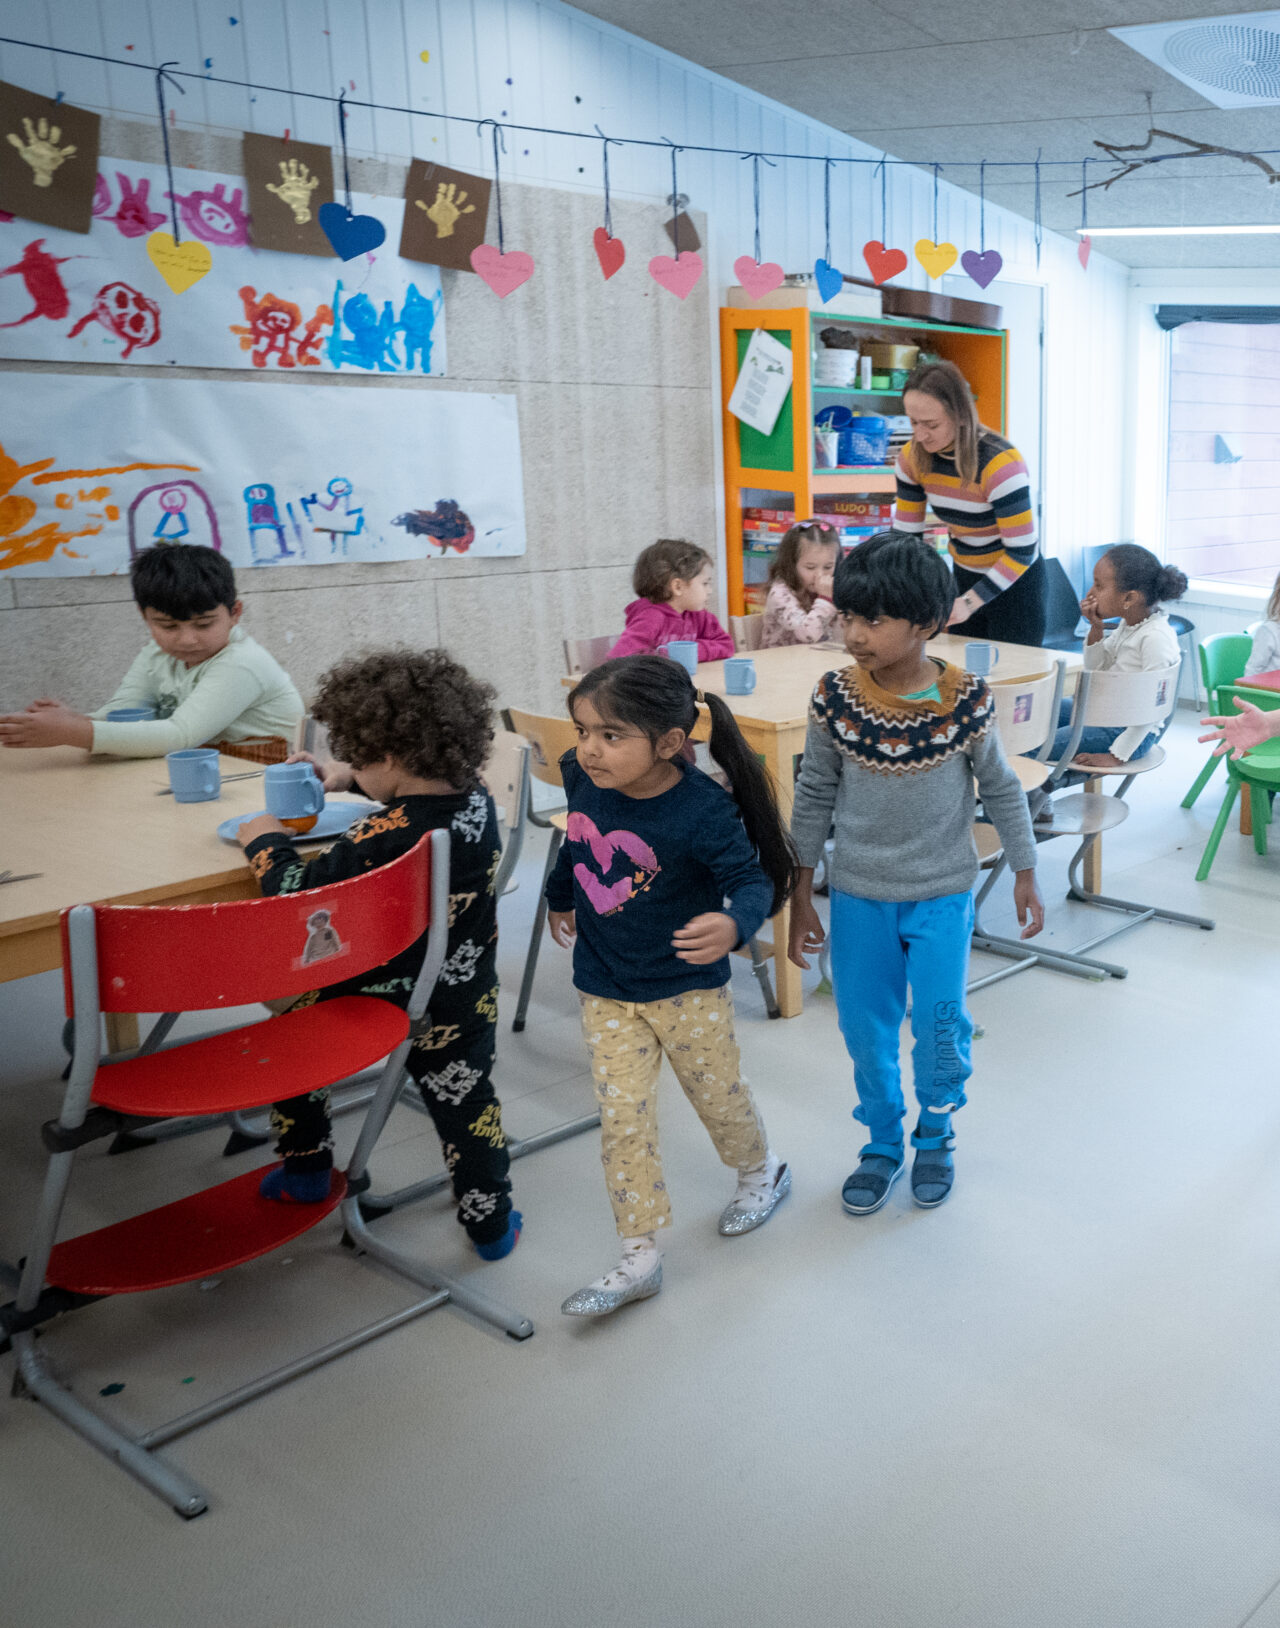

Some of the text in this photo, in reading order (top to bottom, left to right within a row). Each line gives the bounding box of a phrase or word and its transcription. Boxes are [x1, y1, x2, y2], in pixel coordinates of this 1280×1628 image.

[835, 502, 866, 515] LUDO
[420, 1059, 471, 1093] Hug
[436, 1068, 483, 1106] Love
